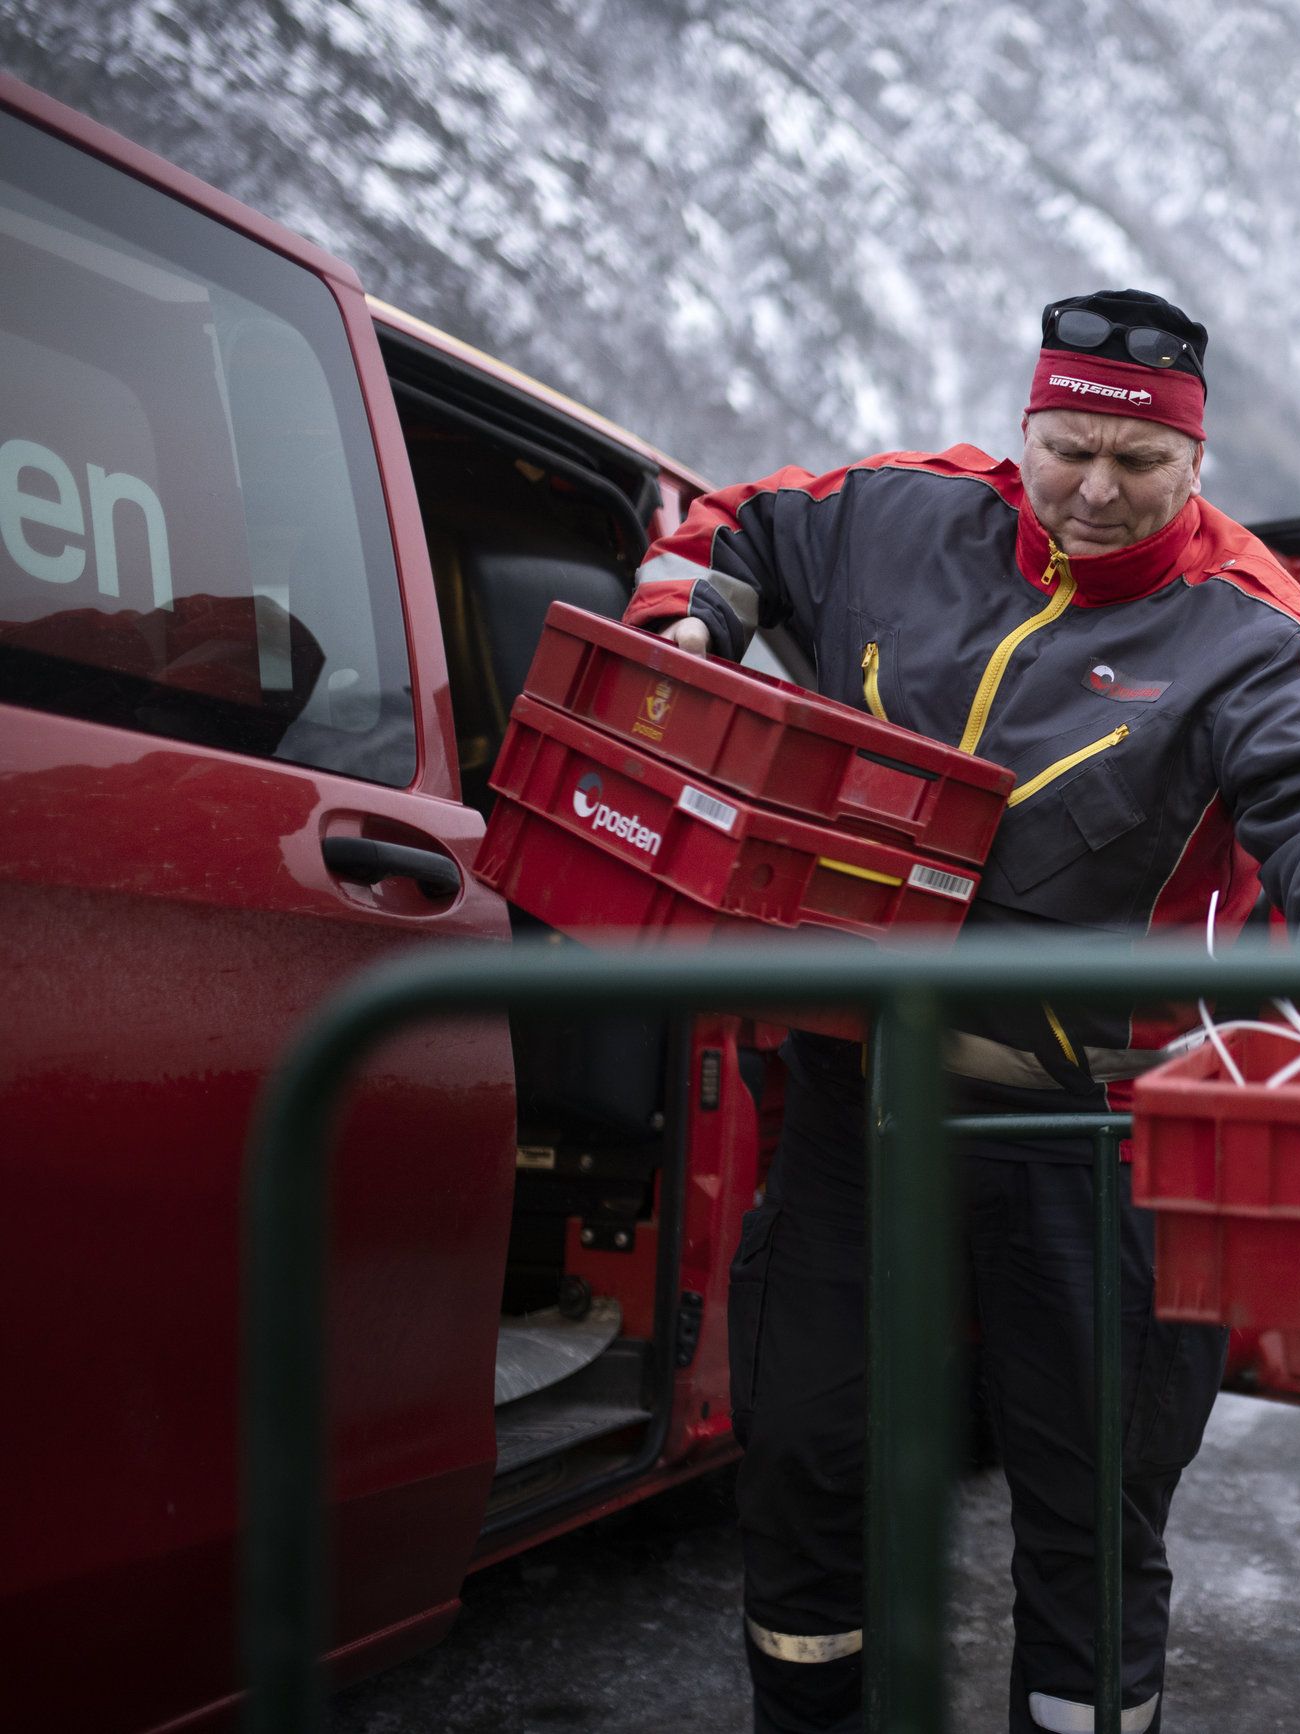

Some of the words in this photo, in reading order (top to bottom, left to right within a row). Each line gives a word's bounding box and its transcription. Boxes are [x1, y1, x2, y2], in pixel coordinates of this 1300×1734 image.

[1049, 376, 1129, 400] postkom
[631, 721, 664, 742] posten
[591, 803, 663, 857] posten
